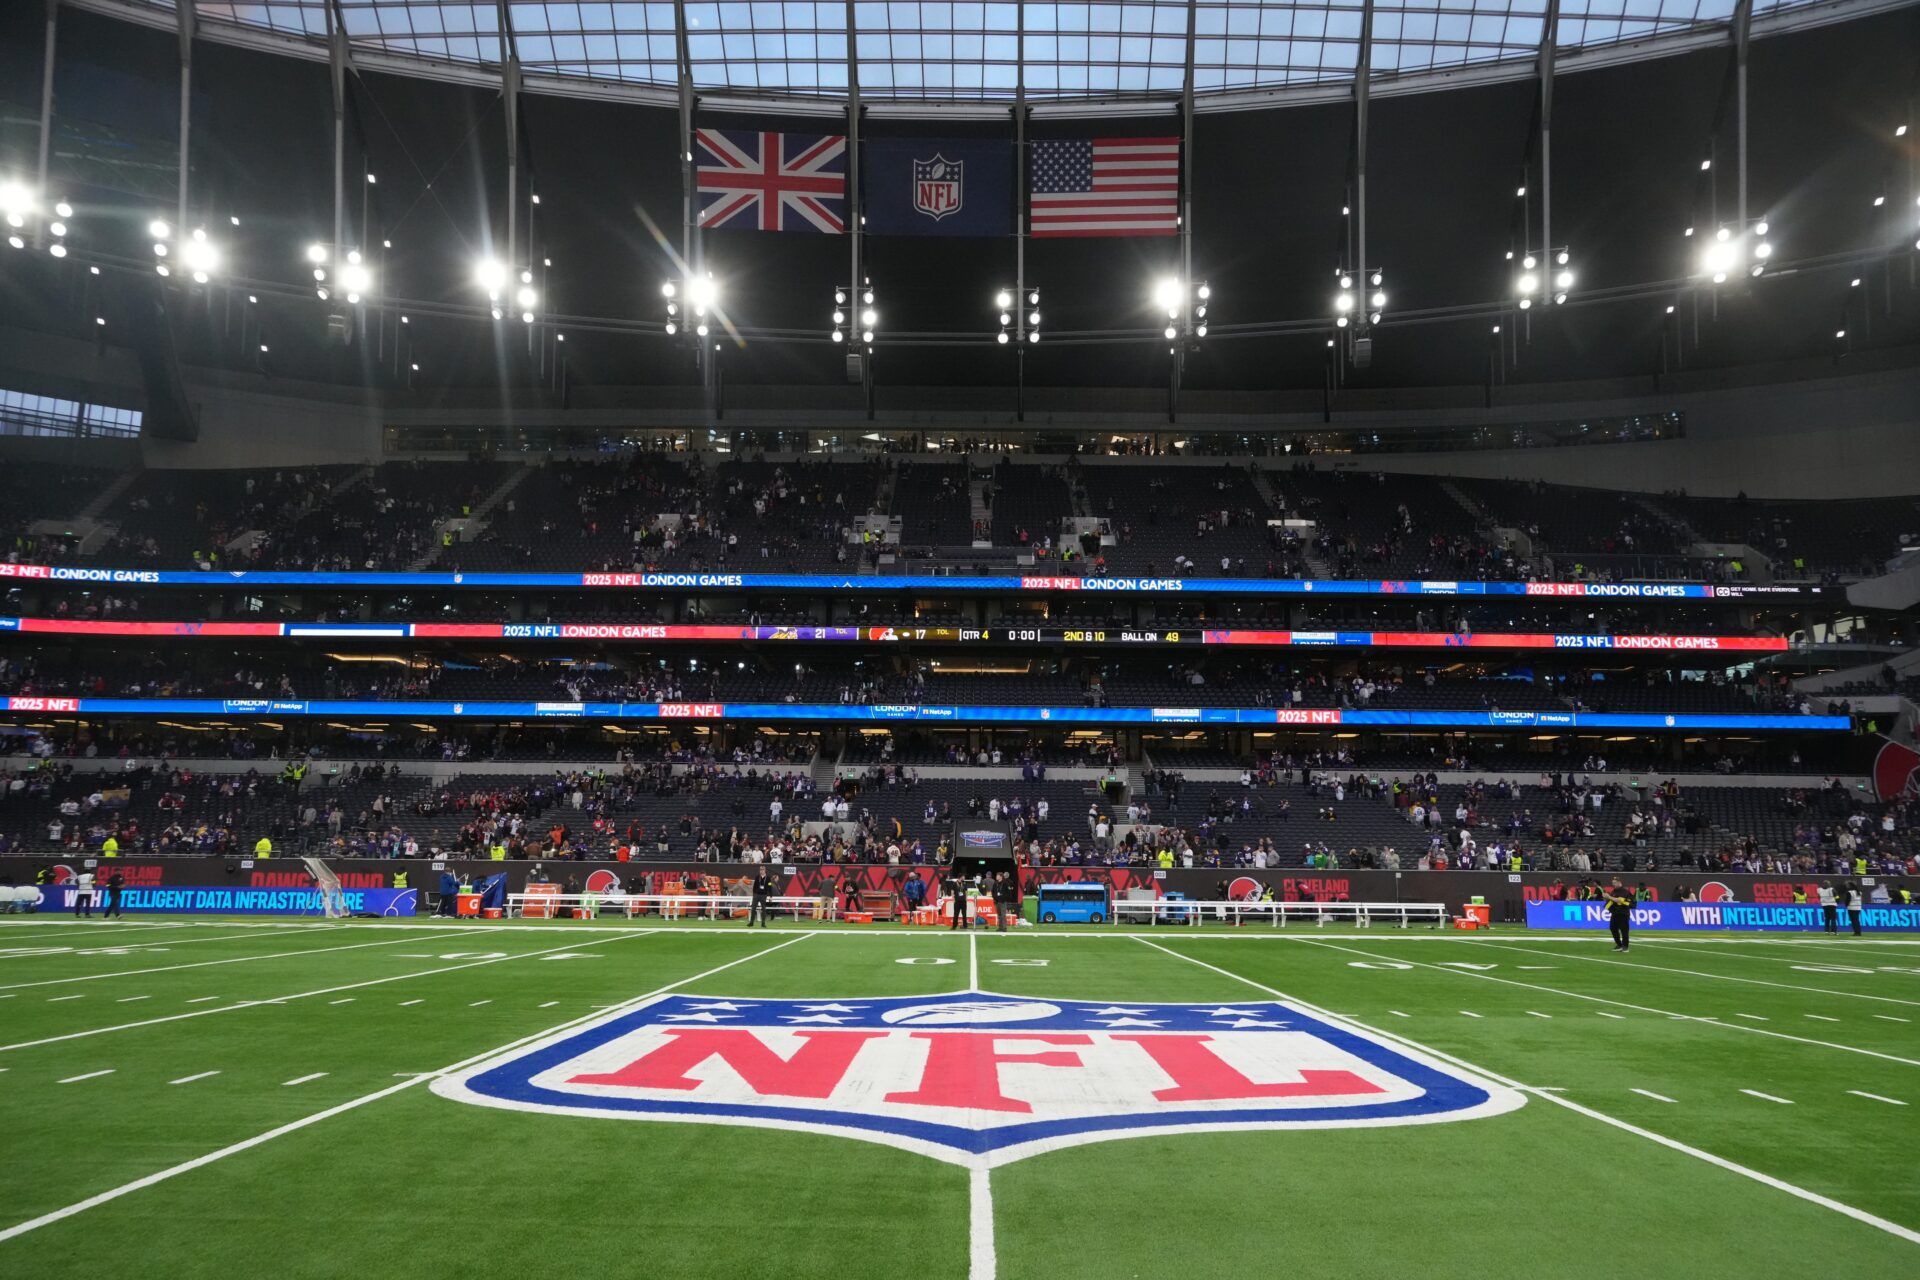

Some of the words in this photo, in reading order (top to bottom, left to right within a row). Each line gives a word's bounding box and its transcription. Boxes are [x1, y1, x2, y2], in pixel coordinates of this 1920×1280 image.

[919, 182, 958, 211] NFL
[0, 565, 14, 576] 25
[18, 566, 47, 578] NFL
[50, 568, 111, 580] LONDON
[114, 571, 159, 582] GAMES
[585, 575, 611, 586] 2025
[615, 575, 639, 586] NFL
[641, 575, 696, 586] LONDON
[699, 576, 742, 586] GAMES
[1023, 578, 1050, 589] 2025
[1054, 579, 1078, 590] NFL
[1081, 579, 1136, 590] LONDON
[1139, 580, 1182, 590] GAMES
[1528, 585, 1554, 595] 2025
[1558, 585, 1582, 595] NFL
[1585, 586, 1639, 596] LONDON
[1642, 586, 1685, 596] GAMES
[504, 626, 531, 637] 2025
[534, 626, 559, 637] NFL
[562, 626, 618, 637] LONDON
[622, 627, 666, 638] GAMES
[815, 629, 825, 639] 21
[916, 629, 926, 640] 17
[962, 630, 980, 640] QTR
[982, 630, 989, 640] 4
[1008, 631, 1035, 641] 0:00
[1064, 632, 1084, 641] 2ND
[1085, 632, 1092, 641] &
[1094, 632, 1105, 642] 10
[1121, 632, 1144, 642] BALL
[1145, 632, 1157, 642] ON
[1165, 632, 1178, 642] 49
[1556, 636, 1583, 647] 2025
[1587, 637, 1612, 648] NFL
[1614, 637, 1671, 648] LONDON
[1674, 638, 1719, 649] GAMES
[12, 698, 44, 710] 2025
[48, 699, 76, 711] NFL
[662, 705, 690, 717] 2025
[694, 705, 720, 717] NFL
[1279, 711, 1308, 723] 2025
[1312, 711, 1338, 723] NFL
[96, 866, 163, 880] CLELAND
[1283, 878, 1350, 892] CLVELAND
[1753, 883, 1819, 898] CLEVELND
[103, 889, 194, 909] ITELLIGENT
[196, 890, 232, 909] DATA
[469, 899, 479, 910] G
[1587, 906, 1661, 926] Nepp
[1681, 907, 1721, 925] WITH
[1722, 907, 1814, 926] INTELLIGENT
[1817, 908, 1852, 927] DTA
[566, 1028, 1389, 1114] NFL
